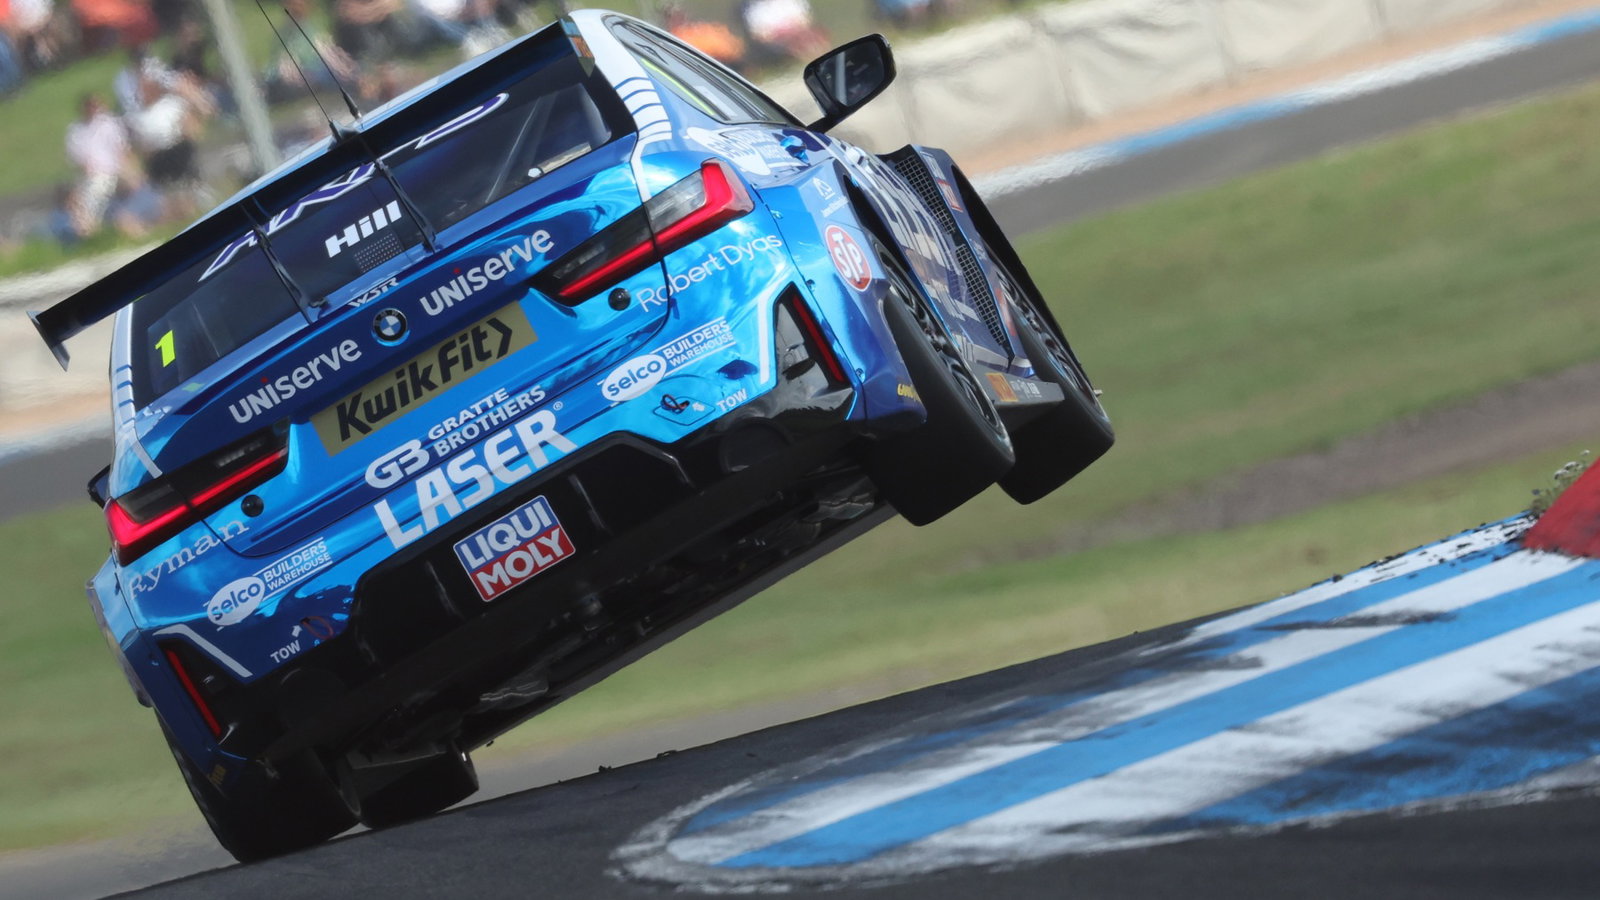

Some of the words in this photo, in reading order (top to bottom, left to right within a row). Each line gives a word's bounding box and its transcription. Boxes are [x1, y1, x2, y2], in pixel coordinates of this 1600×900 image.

[325, 200, 402, 258] Hill
[636, 253, 725, 313] Robert
[719, 234, 783, 265] Dyas
[832, 231, 866, 284] STP
[348, 277, 399, 307] WSR
[155, 330, 176, 368] 1
[663, 320, 731, 360] BUILDERS
[669, 331, 734, 368] WAREHOUSE
[607, 359, 662, 397] selco
[428, 387, 510, 440] GRATTE
[433, 385, 546, 457] BROTHERS
[716, 389, 749, 412] TOW
[461, 501, 553, 570] LIQUI
[129, 520, 250, 600] Ryman
[263, 541, 328, 584] BUILDERS
[267, 551, 331, 592] WAREHOUSE
[477, 528, 567, 596] MOLY
[211, 583, 261, 621] selco
[269, 640, 301, 663] TOW
